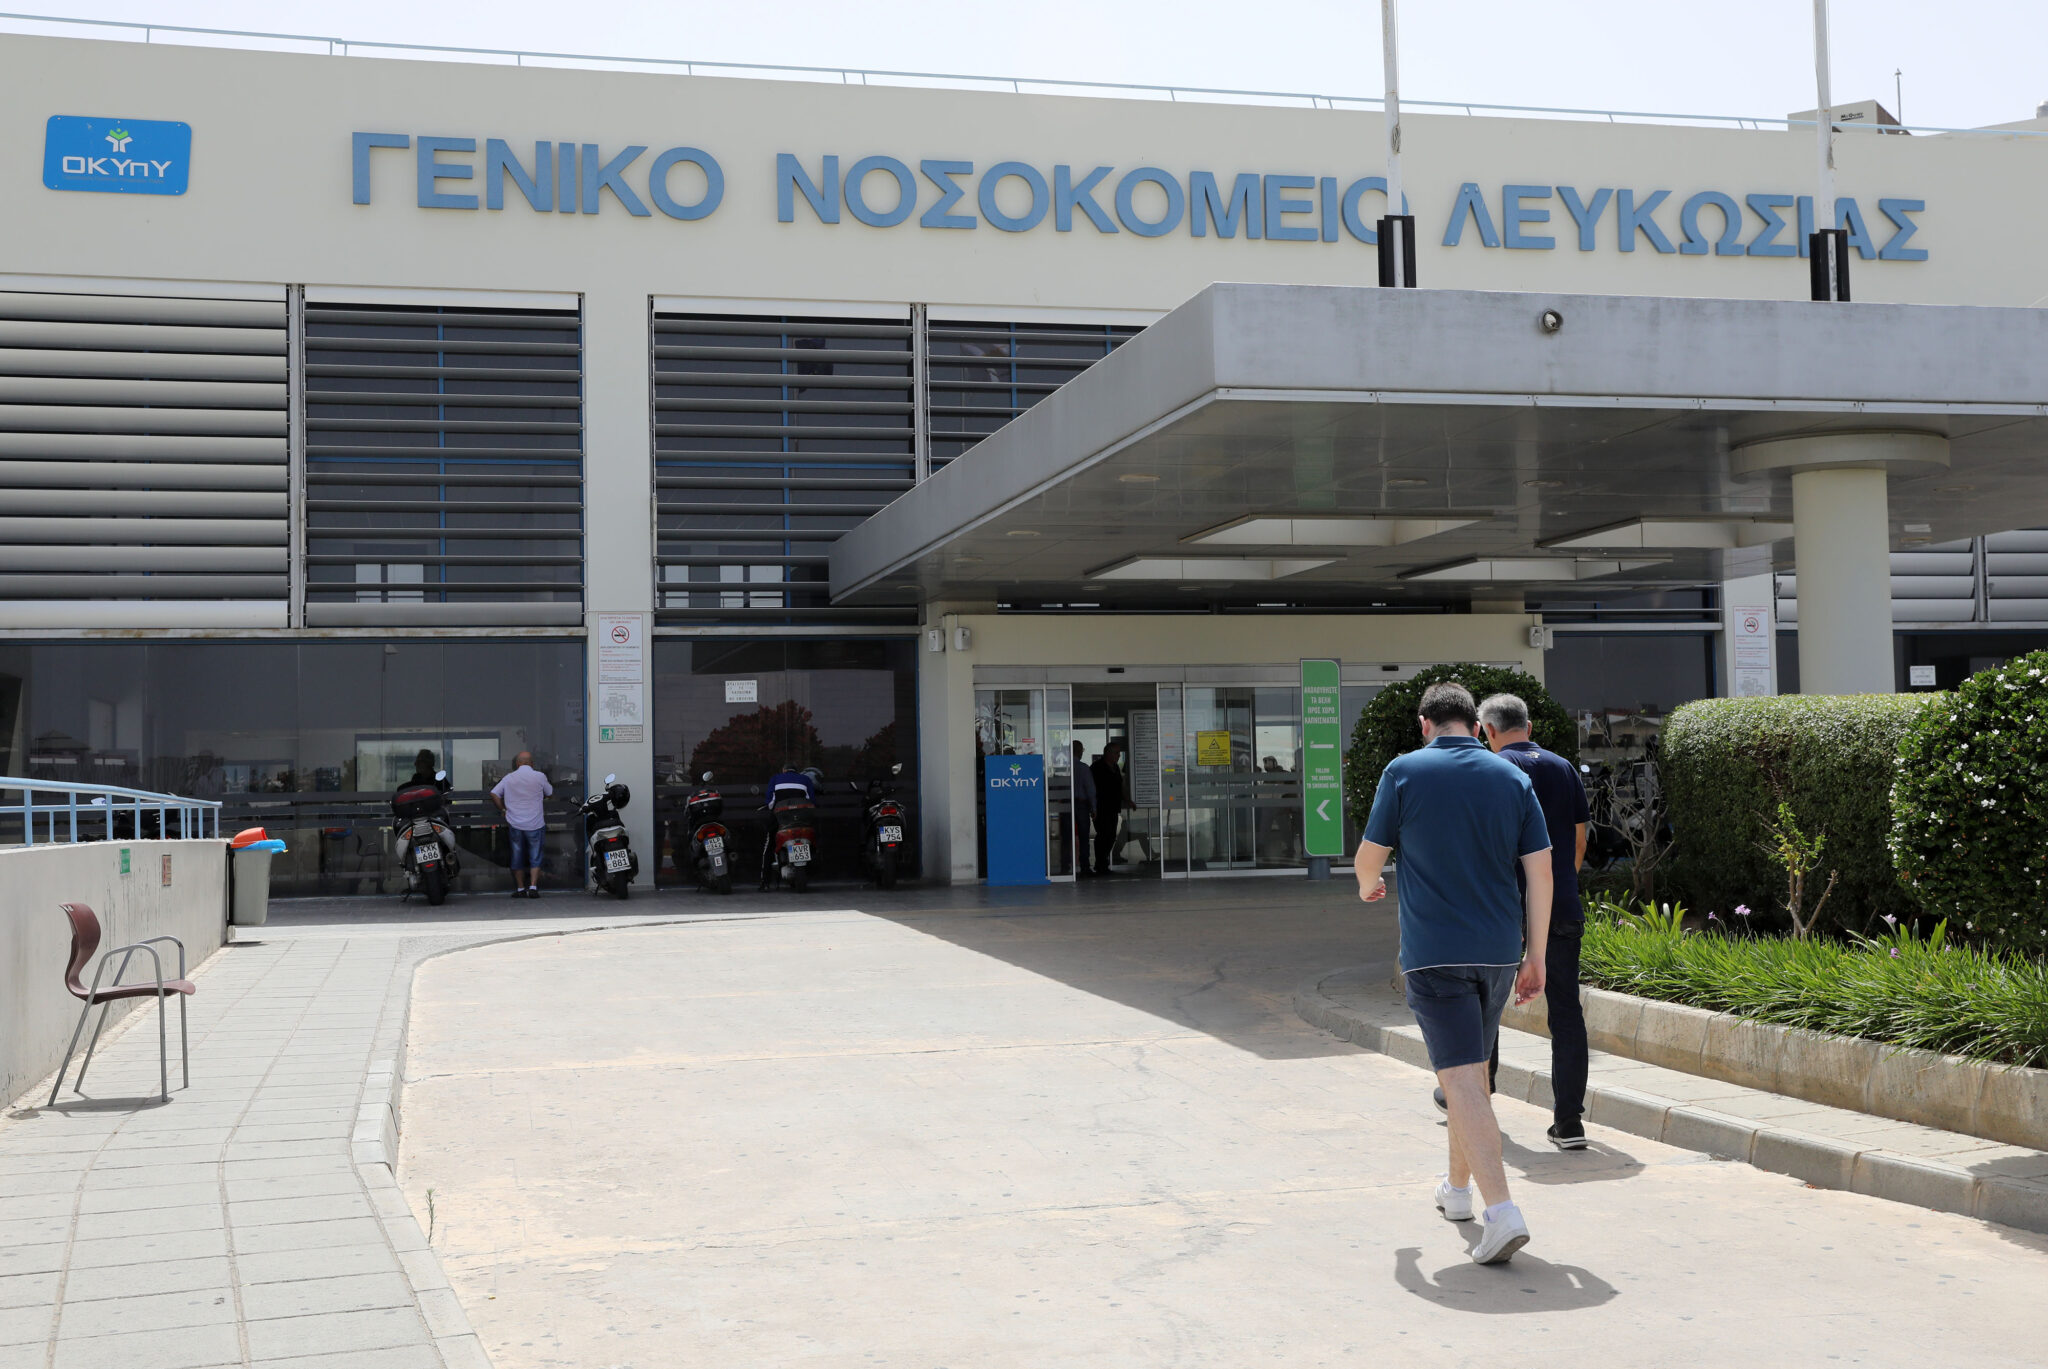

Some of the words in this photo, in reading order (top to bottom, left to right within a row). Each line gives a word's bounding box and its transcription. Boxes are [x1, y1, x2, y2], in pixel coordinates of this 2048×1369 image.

[352, 132, 725, 221] ΓΕΝΙΚΟ
[776, 153, 1409, 246] ΝΟΣΟΚΟΜΕΙΟ
[1441, 182, 1929, 262] ΛΕΥΚΩΣΙΑΣ
[885, 826, 900, 834] KYS
[886, 833, 901, 841] 754
[420, 843, 437, 854] KXK
[793, 845, 808, 854] KVR
[423, 851, 438, 860] 686
[609, 850, 626, 860] MNB
[795, 852, 809, 860] 653
[612, 858, 628, 867] 881
